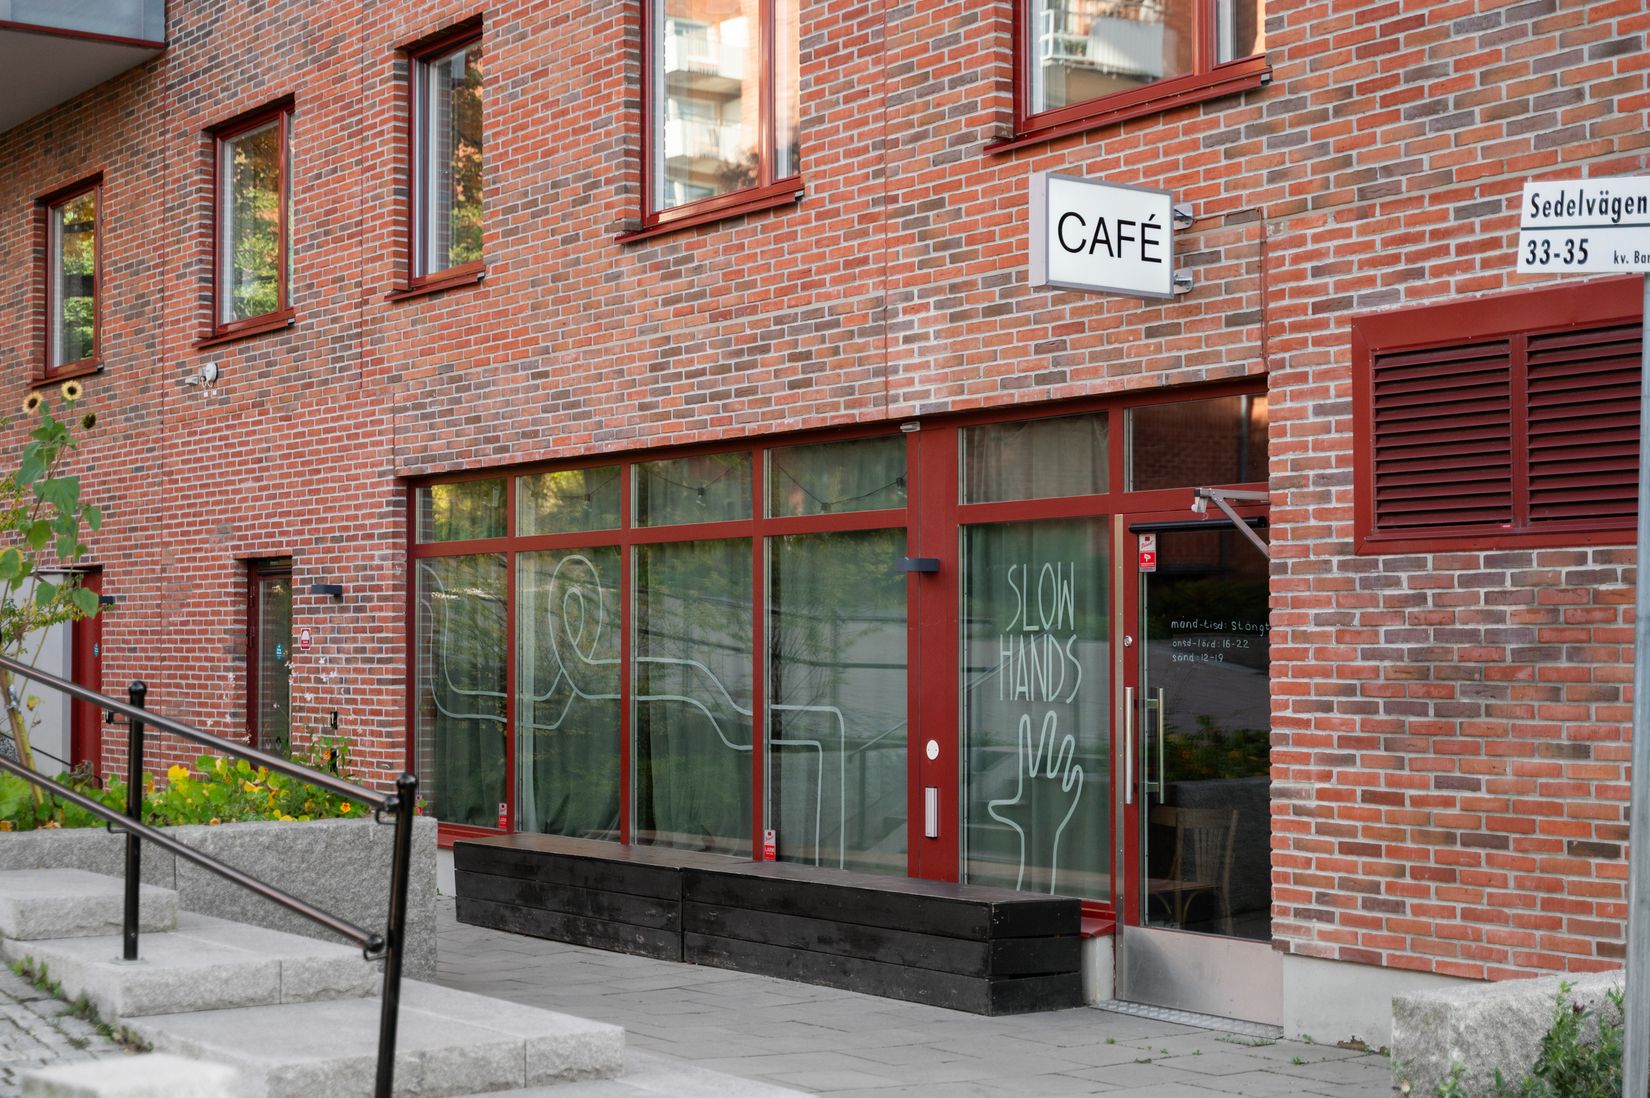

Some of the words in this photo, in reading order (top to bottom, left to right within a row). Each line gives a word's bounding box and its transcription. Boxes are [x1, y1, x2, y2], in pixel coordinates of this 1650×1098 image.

[1530, 189, 1648, 224] Sedelvägen
[1057, 211, 1162, 263] CAFÉ
[1525, 238, 1589, 265] 33-35
[1613, 250, 1629, 265] kv.
[1006, 561, 1075, 631] SLOW
[1000, 633, 1082, 704] HANDS
